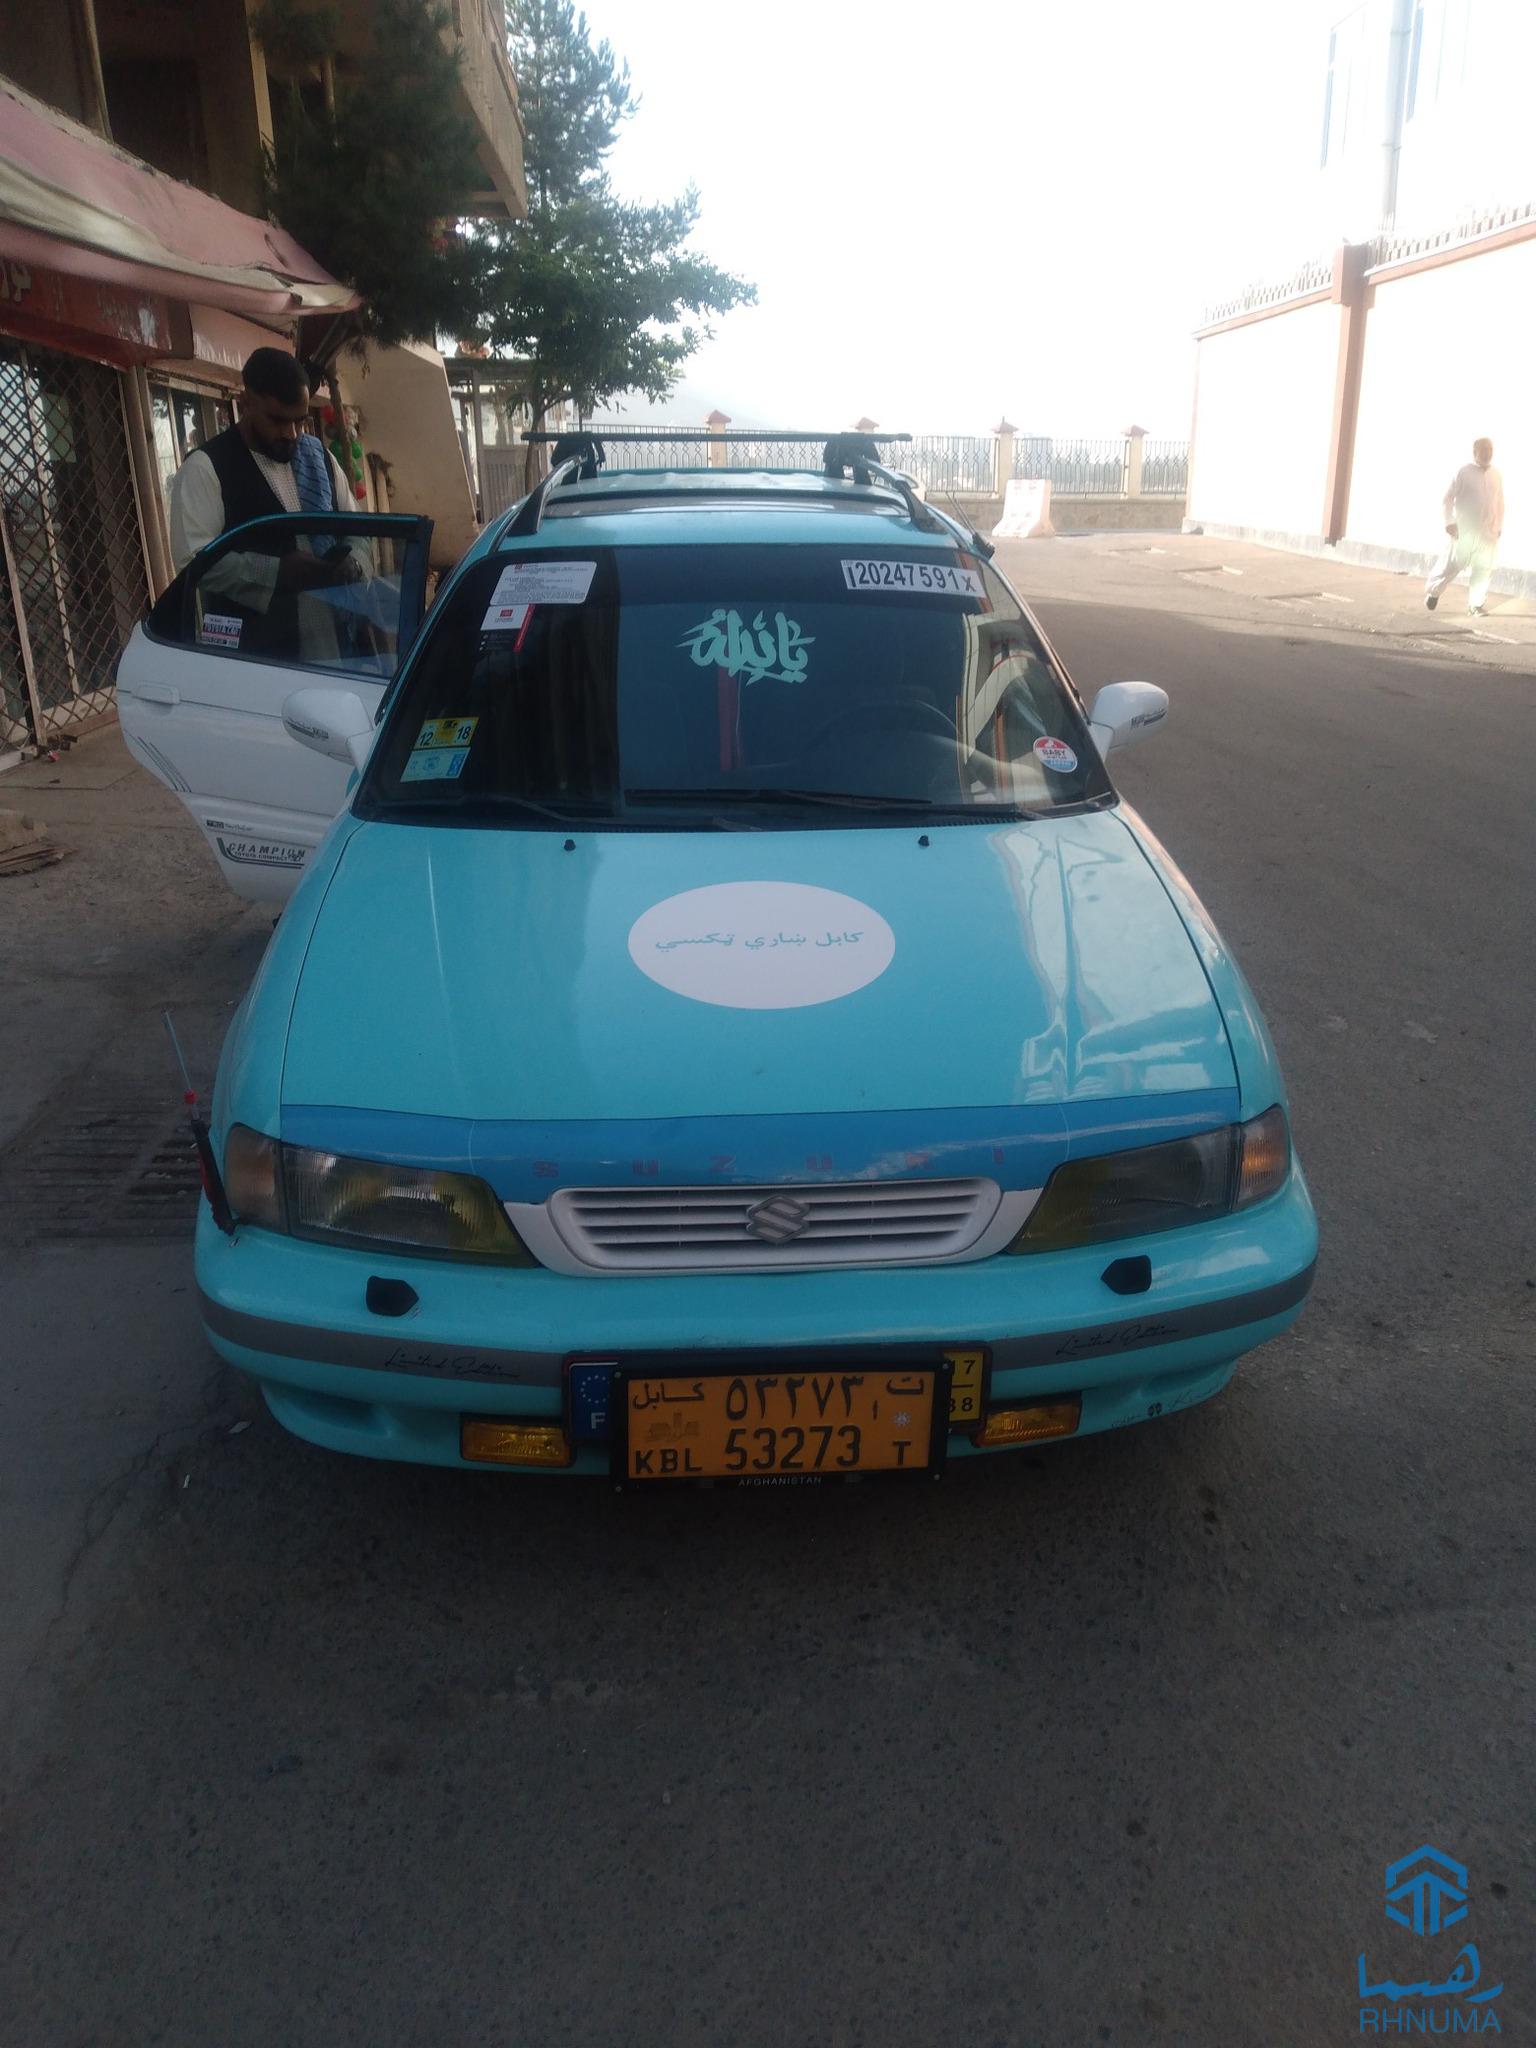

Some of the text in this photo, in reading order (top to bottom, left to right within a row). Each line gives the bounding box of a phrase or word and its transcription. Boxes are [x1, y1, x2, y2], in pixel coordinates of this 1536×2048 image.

[419, 731, 434, 746] 12
[457, 726, 472, 740] 18
[591, 1412, 606, 1429] F
[724, 1425, 862, 1471] 53273
[892, 1440, 912, 1466] T
[634, 1447, 703, 1475] KBL
[737, 1476, 822, 1488] AFGHANISTAN
